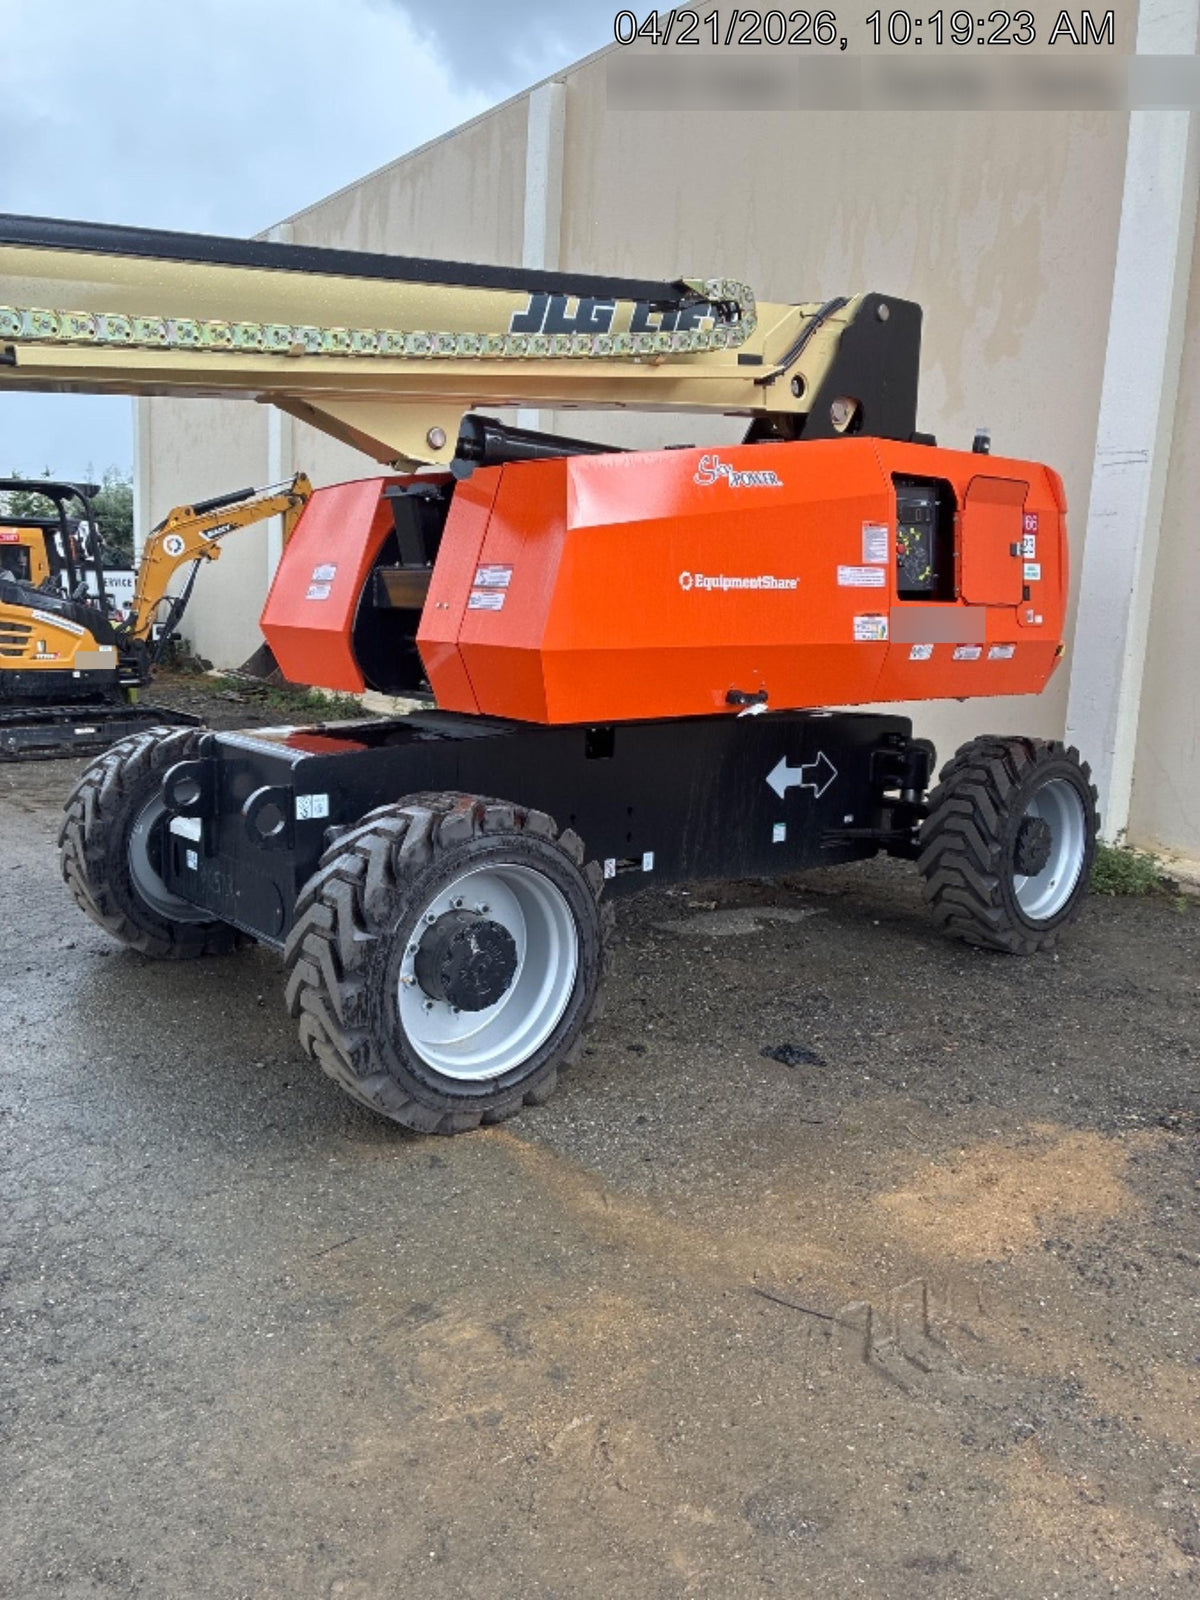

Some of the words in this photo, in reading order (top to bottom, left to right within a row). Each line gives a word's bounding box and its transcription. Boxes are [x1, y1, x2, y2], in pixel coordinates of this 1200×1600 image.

[508, 294, 617, 335] JLG
[103, 577, 133, 587] ERVICE
[694, 573, 797, 591] EquipmentShare
